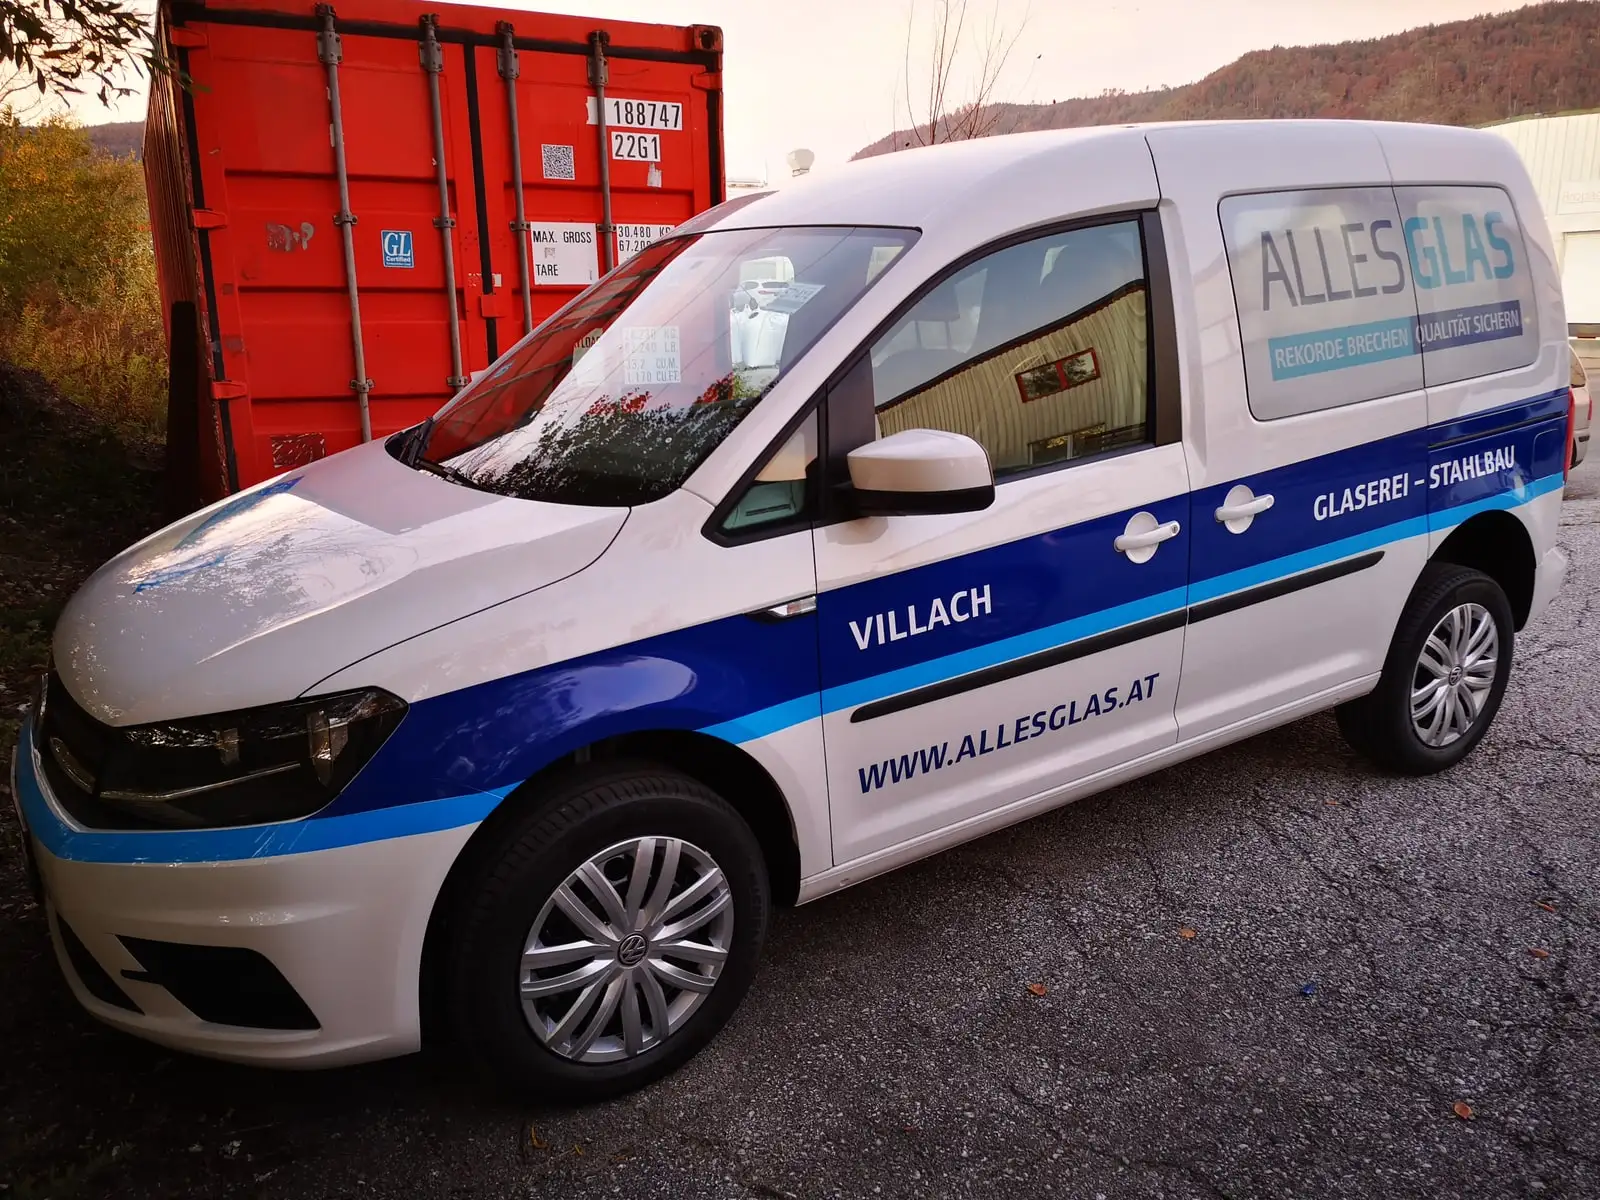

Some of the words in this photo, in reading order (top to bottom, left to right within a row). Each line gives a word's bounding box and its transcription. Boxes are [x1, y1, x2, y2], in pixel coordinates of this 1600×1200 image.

[613, 100, 681, 129] 188747
[614, 134, 659, 160] 22G1
[383, 232, 411, 256] GL
[532, 230, 558, 244] MAX.
[563, 230, 592, 244] GROSS
[618, 226, 651, 239] 30.480
[535, 263, 559, 277] TARE
[1274, 339, 1345, 369] REKORDE
[1347, 327, 1409, 357] BRECHEN
[1414, 313, 1472, 348] QUALITÄT
[1473, 308, 1520, 335] SICHERN
[1313, 472, 1409, 521] GLASEREI
[1428, 445, 1516, 489] STAHLBAU
[848, 583, 993, 651] VILLACH
[858, 672, 1161, 795] WWW.ALLESGLAS.AT
